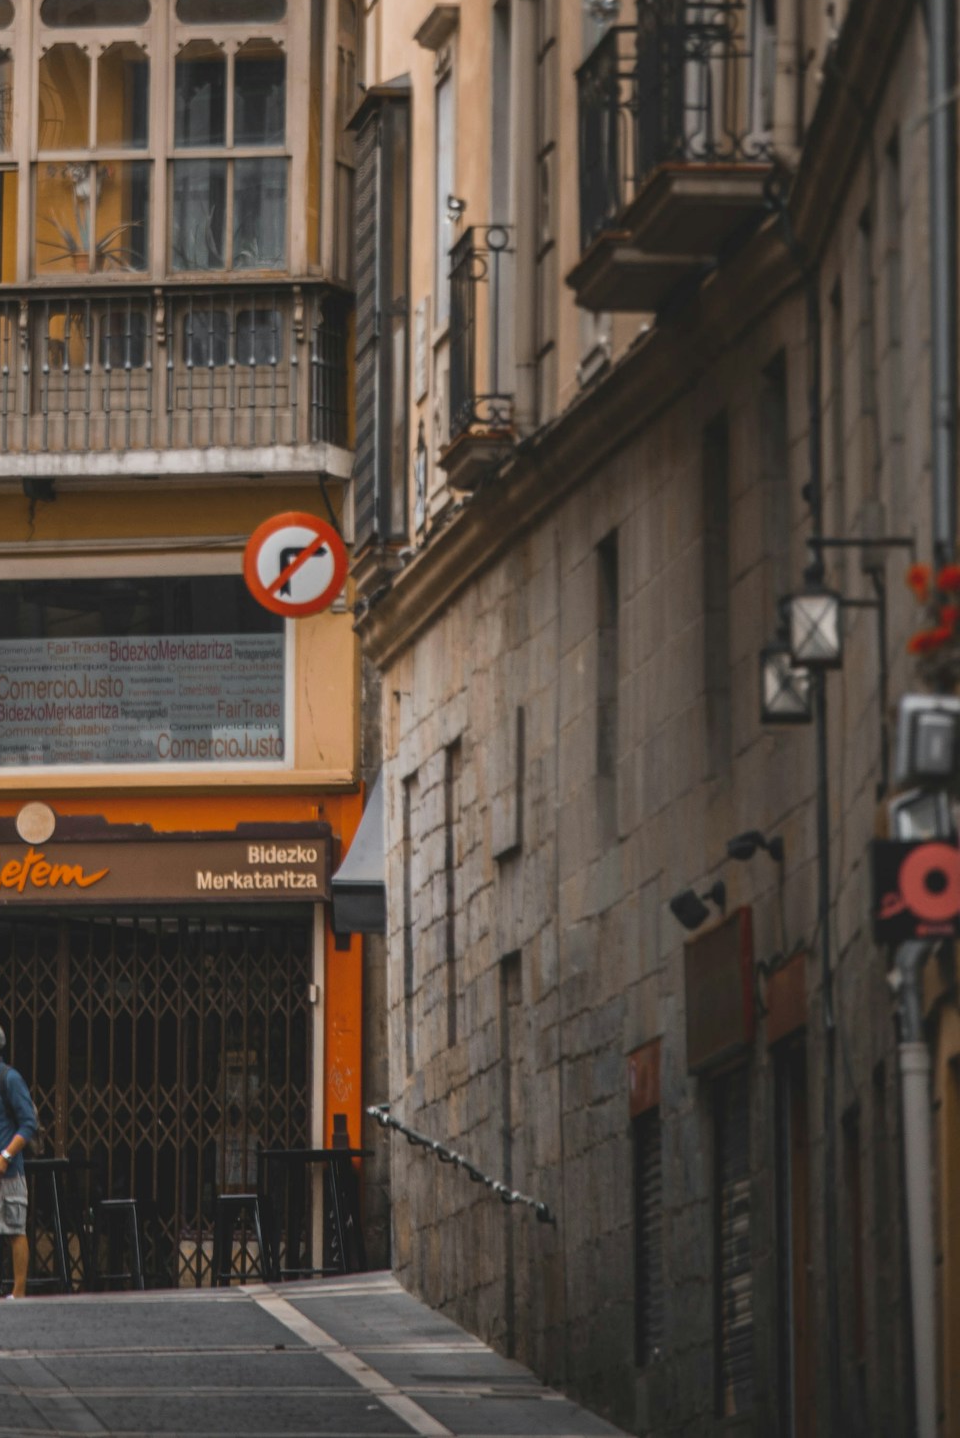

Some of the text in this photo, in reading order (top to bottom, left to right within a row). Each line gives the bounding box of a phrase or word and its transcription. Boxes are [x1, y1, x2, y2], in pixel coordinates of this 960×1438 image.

[47, 640, 108, 654] FairTrade
[109, 639, 233, 661] BidezkoMerkataritza
[217, 699, 281, 718] FairTrade
[157, 731, 285, 759] ComercioJusto
[247, 845, 318, 865] Bidezko
[196, 869, 319, 891] Merkataritza
